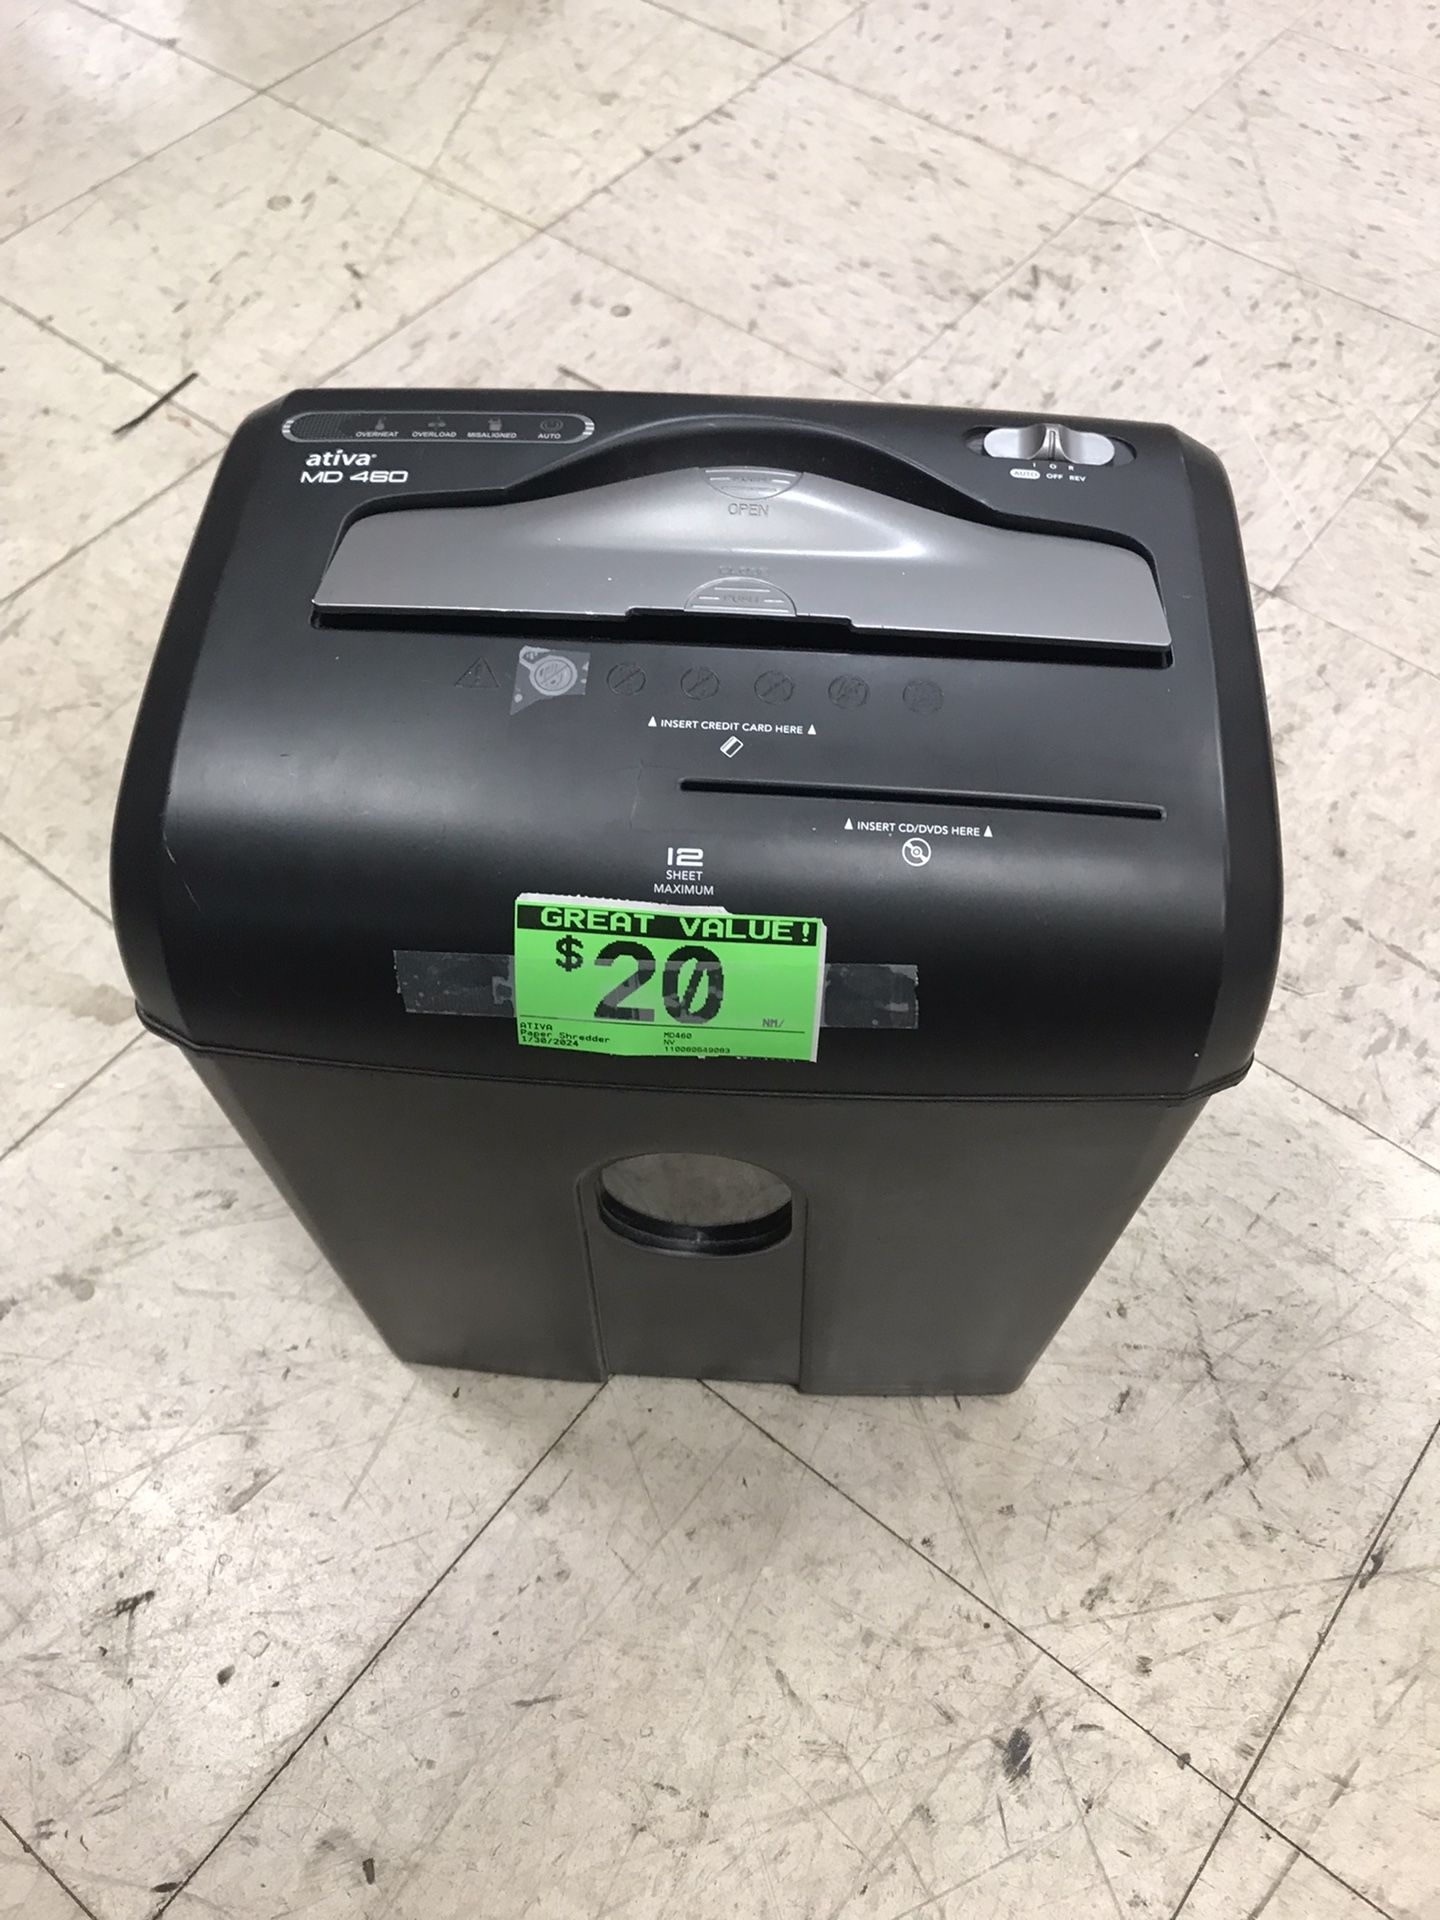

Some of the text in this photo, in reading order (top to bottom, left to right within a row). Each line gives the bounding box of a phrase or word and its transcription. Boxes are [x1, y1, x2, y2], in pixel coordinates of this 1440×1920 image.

[411, 431, 457, 439] OVERLOAD
[467, 431, 517, 439] MISALIGNED
[537, 432, 561, 440] AUTO
[300, 470, 409, 483] MD 460
[1069, 474, 1086, 482] REV
[727, 503, 769, 516] OPEN
[660, 719, 804, 735] INSERT CREDIT CARD HERE
[857, 821, 981, 837] INSERT CD/DVDS HERE
[667, 847, 704, 867] 12
[665, 869, 703, 881] SHEET
[653, 883, 715, 896] MAXIMUM
[540, 906, 811, 943] GREAT VALUE!
[520, 1021, 553, 1031] ATIVA
[520, 1028, 611, 1043] Paper Shredder
[521, 1035, 579, 1047] 1/30/2024
[663, 1031, 692, 1040] MD460
